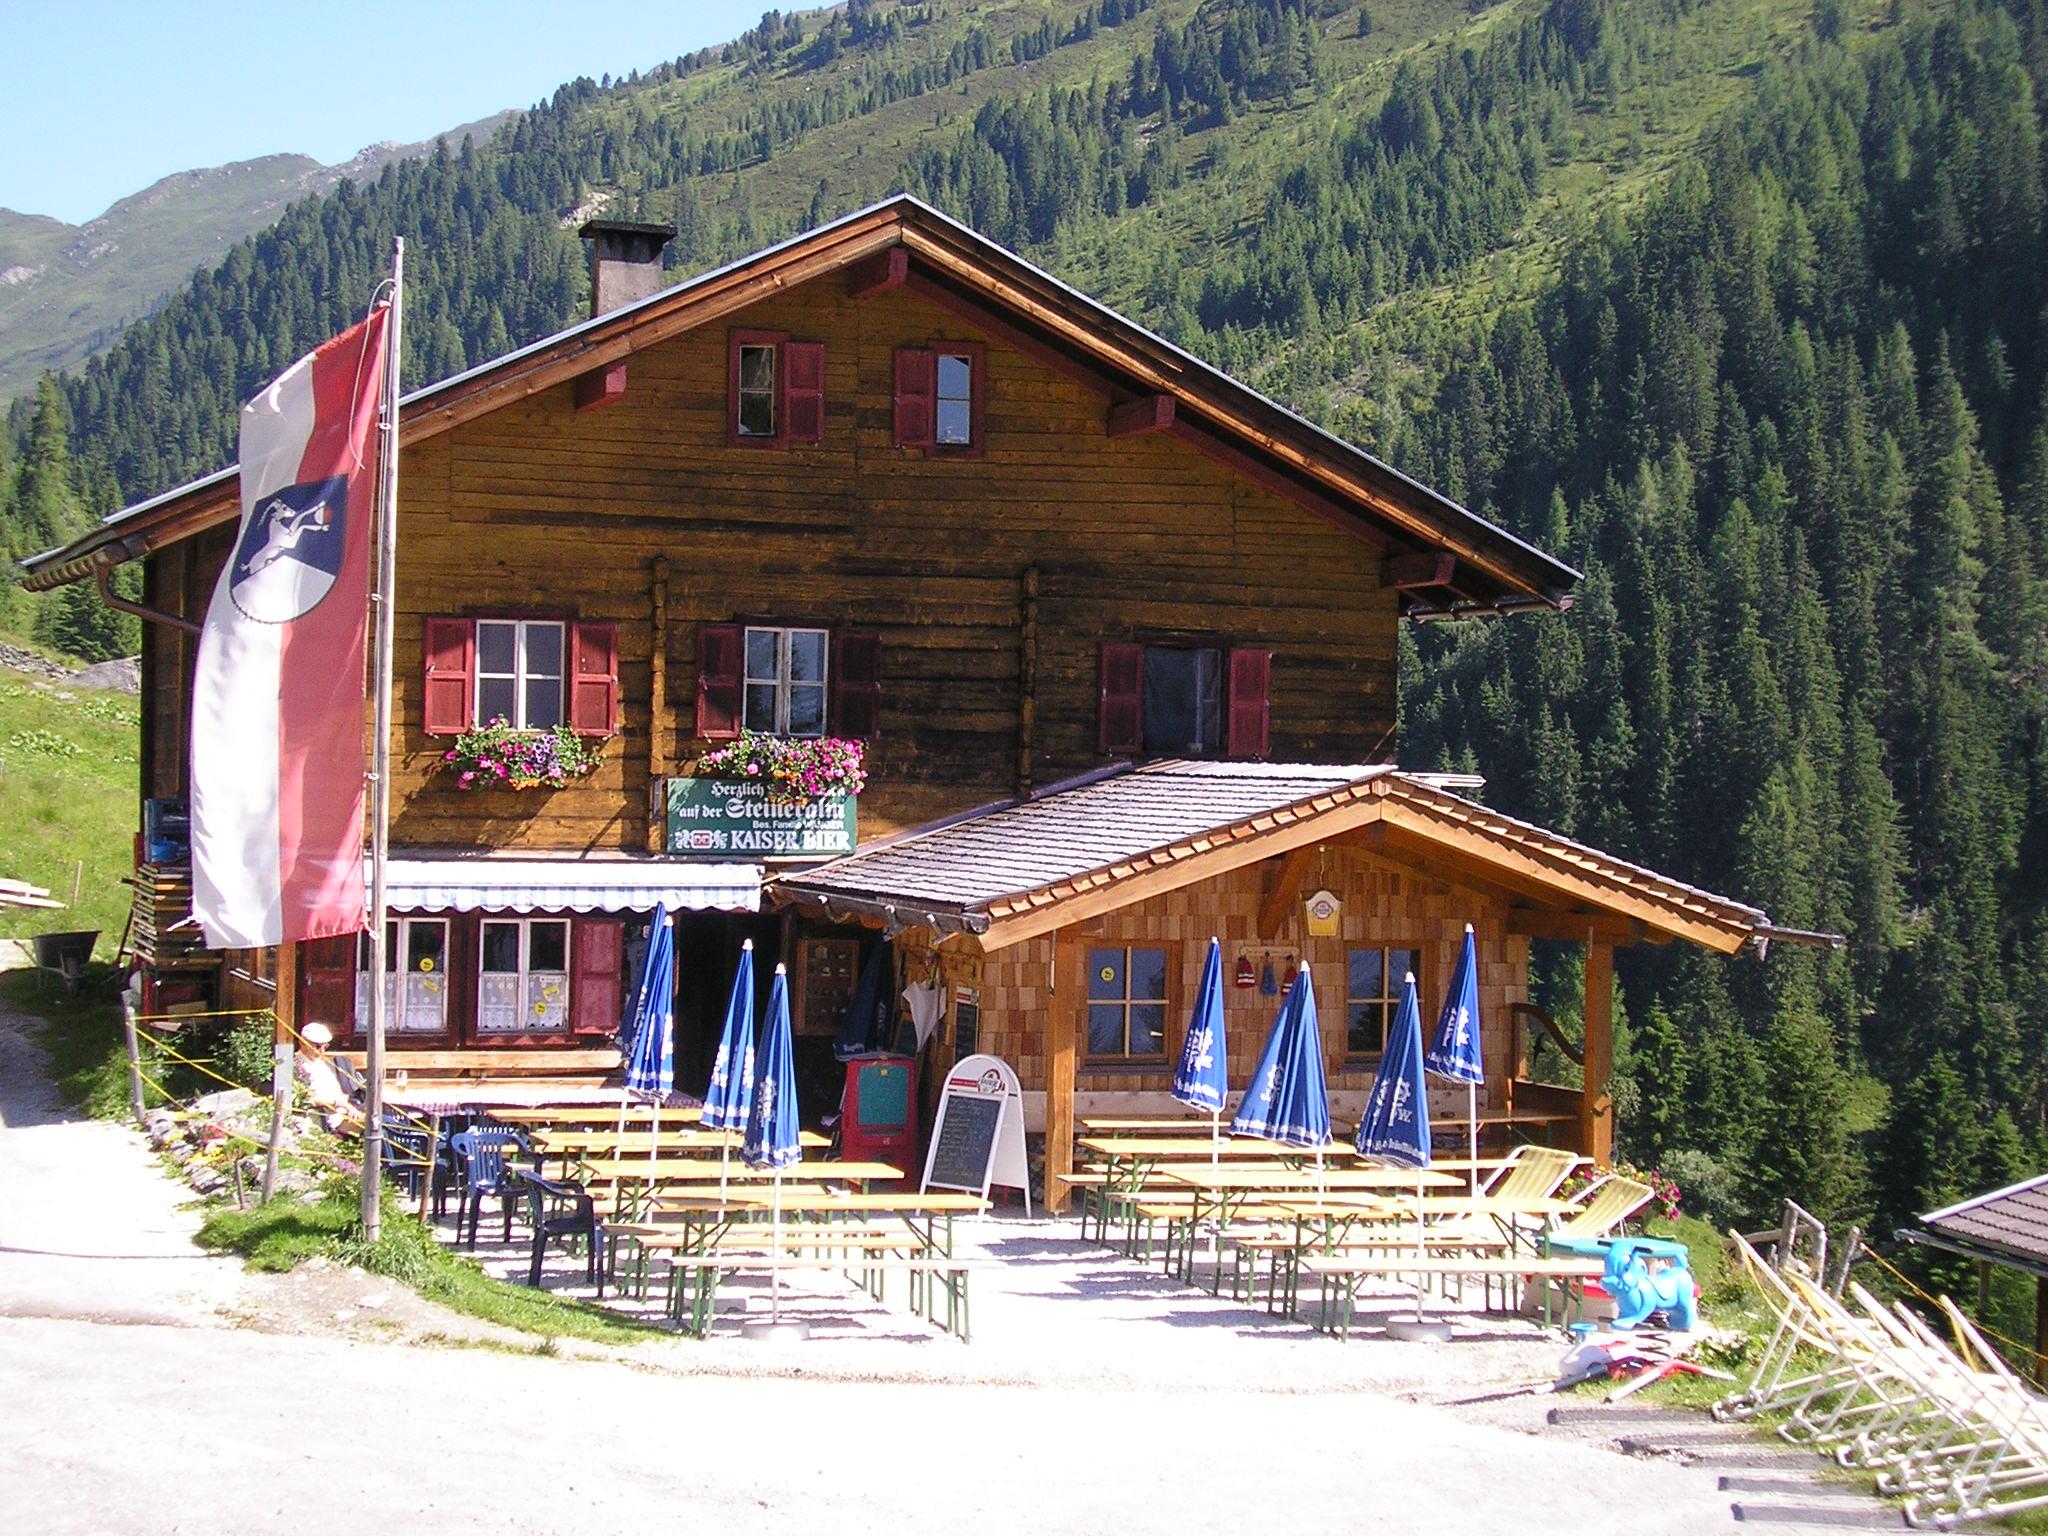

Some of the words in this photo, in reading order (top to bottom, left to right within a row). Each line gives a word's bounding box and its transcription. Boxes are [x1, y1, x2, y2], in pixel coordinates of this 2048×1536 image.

[711, 781, 764, 798] Herzlich
[679, 804, 700, 820] auf
[702, 804, 723, 818] der
[725, 797, 846, 819] Steineralm
[731, 830, 800, 850] KAISER
[802, 830, 852, 850] BIER
